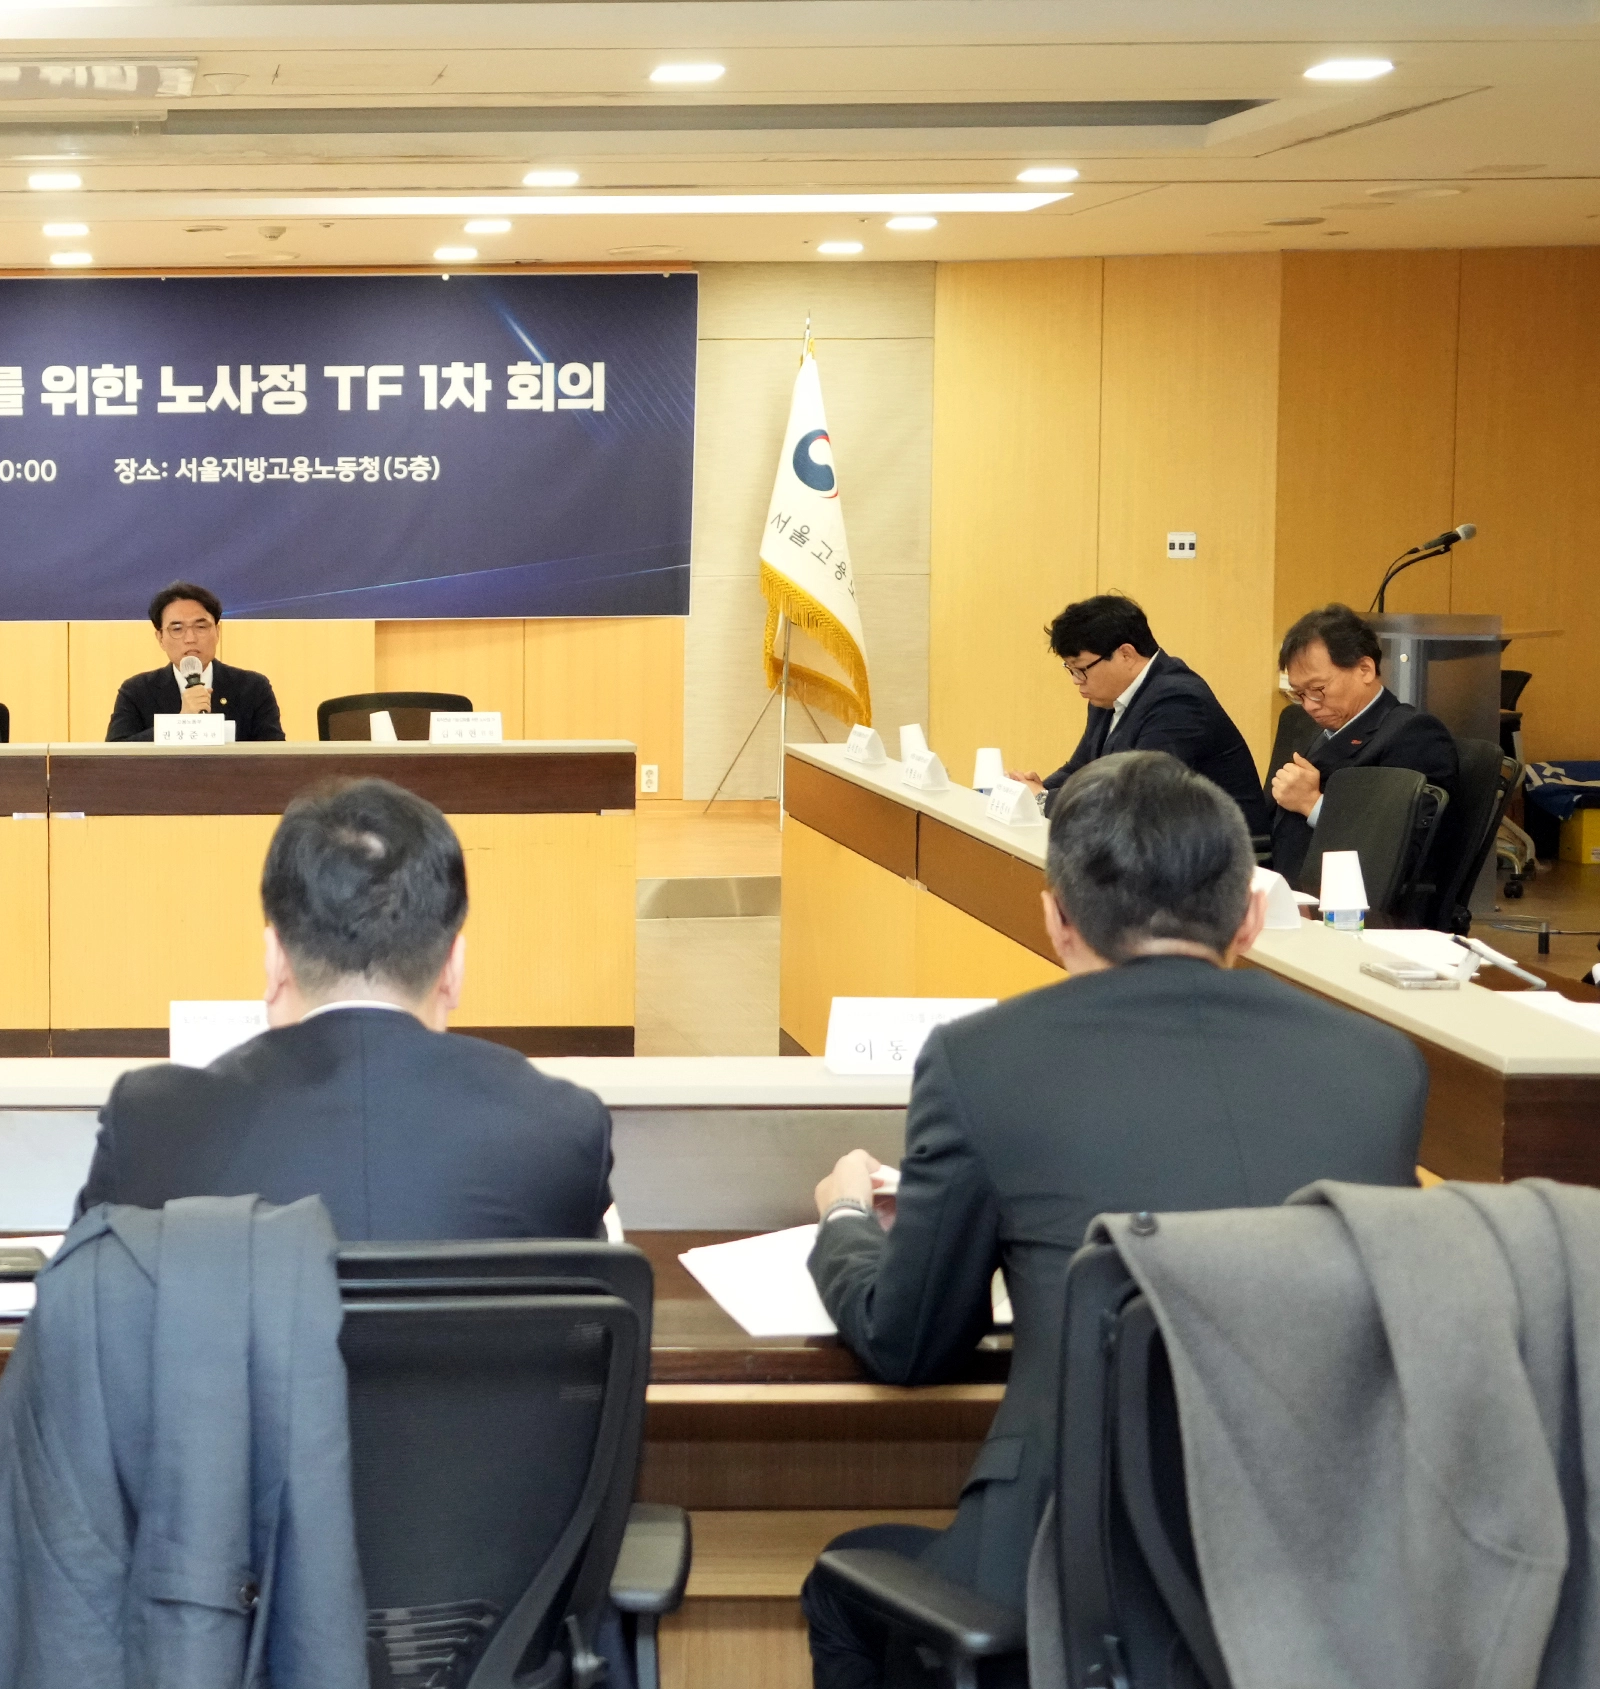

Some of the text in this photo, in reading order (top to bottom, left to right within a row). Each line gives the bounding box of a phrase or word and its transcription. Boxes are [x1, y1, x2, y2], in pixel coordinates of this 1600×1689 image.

[40, 363, 143, 417] 위한
[156, 363, 308, 415] 노사정
[323, 364, 405, 411] TF
[418, 361, 493, 413] 1차
[506, 360, 606, 413] 회의
[113, 457, 168, 485] 장소:
[174, 454, 441, 484] 서울지방고용노동청(5층)
